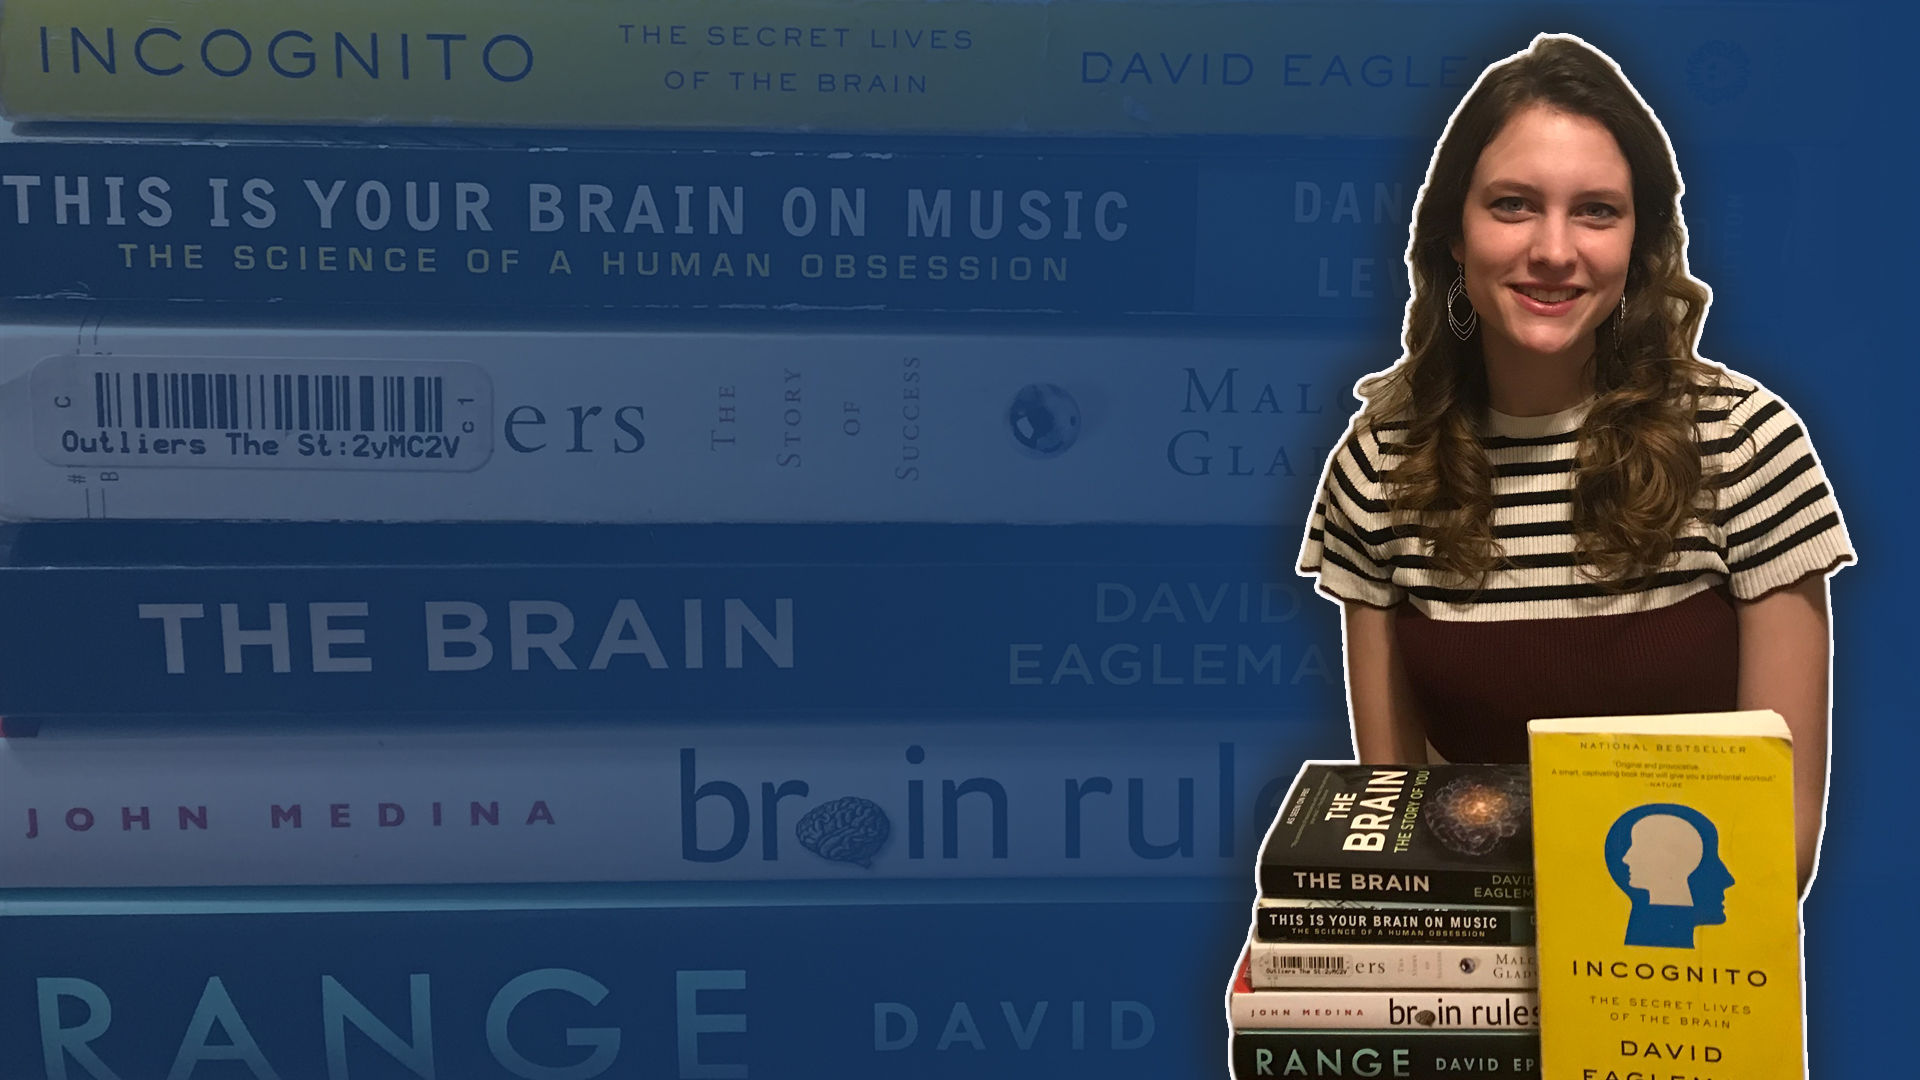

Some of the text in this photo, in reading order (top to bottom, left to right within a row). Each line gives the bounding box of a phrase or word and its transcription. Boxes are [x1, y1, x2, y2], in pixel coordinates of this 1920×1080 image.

[619, 25, 971, 49] THE SECRET LIVES
[39, 27, 533, 82] INCOGNITO
[1082, 52, 1482, 88] DAVID EAGLE
[665, 71, 925, 93] OF THE BRAIN
[3, 176, 1127, 241] THIS IS YOUR BRAIN ON MUSIC
[118, 244, 1066, 281] THE SCIENCE OF A HUMAN OBSESSION
[505, 406, 645, 453] ers
[711, 386, 735, 451] THE
[777, 368, 801, 467] STORY
[844, 402, 860, 436] OF
[895, 358, 920, 481] SUCCESS
[62, 429, 207, 455] Outliers
[226, 431, 279, 456] The
[1096, 582, 1301, 623] DAVID
[139, 598, 793, 673] THE BRAIN
[1580, 742, 1746, 753] NATIONAL BESTSELLER
[1621, 770, 1637, 778] book
[1706, 773, 1741, 781] prefrontal
[26, 801, 555, 839] JOHN MEDINA
[680, 744, 1009, 870] brin
[1324, 792, 1358, 821] THE
[1342, 770, 1408, 851] BRAIN
[1394, 770, 1430, 853] THE STORY OF YOU
[1293, 872, 1429, 891] THE BRAIN
[1270, 914, 1496, 928] THIS IS YOUR BRAIN ON MUSIC
[1314, 928, 1356, 936] SCIENCE
[1388, 929, 1424, 937] HUMAN
[1429, 930, 1486, 938] OBSESSION
[1356, 963, 1385, 973] ers
[1573, 959, 1768, 988] INCOGNITO
[1389, 998, 1461, 1027] brin
[1591, 996, 1750, 1014] THE SECRET LIVES
[37, 969, 747, 1080] RANGE
[874, 1001, 1155, 1051] DAVID
[1640, 1014, 1669, 1024] THE
[1681, 1017, 1729, 1029] BRAIN
[1257, 1048, 1409, 1076] RANGE
[1436, 1058, 1535, 1072] DAVID EP
[1621, 1041, 1721, 1062] DAVID
